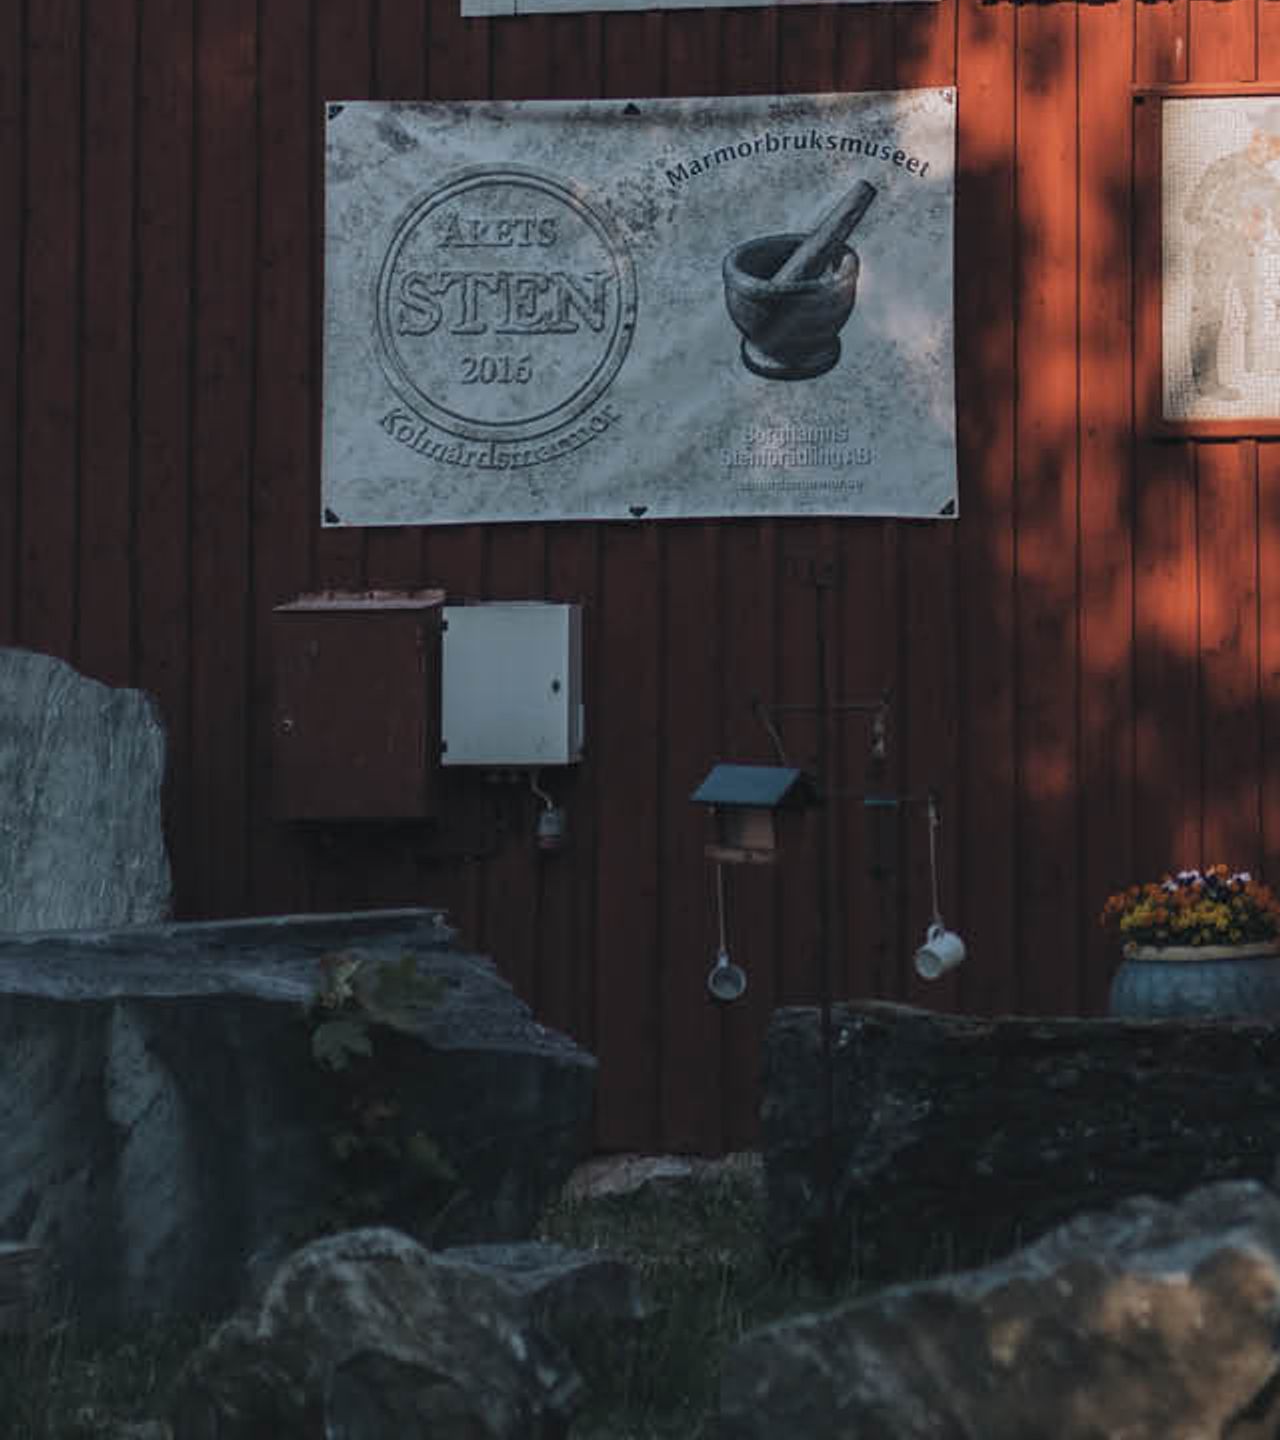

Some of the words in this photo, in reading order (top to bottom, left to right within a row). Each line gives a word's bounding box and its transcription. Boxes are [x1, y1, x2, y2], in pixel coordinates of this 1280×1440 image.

[664, 128, 931, 188] Marmorbruksmuseet
[399, 269, 610, 337] STEN
[461, 356, 533, 384] 2016
